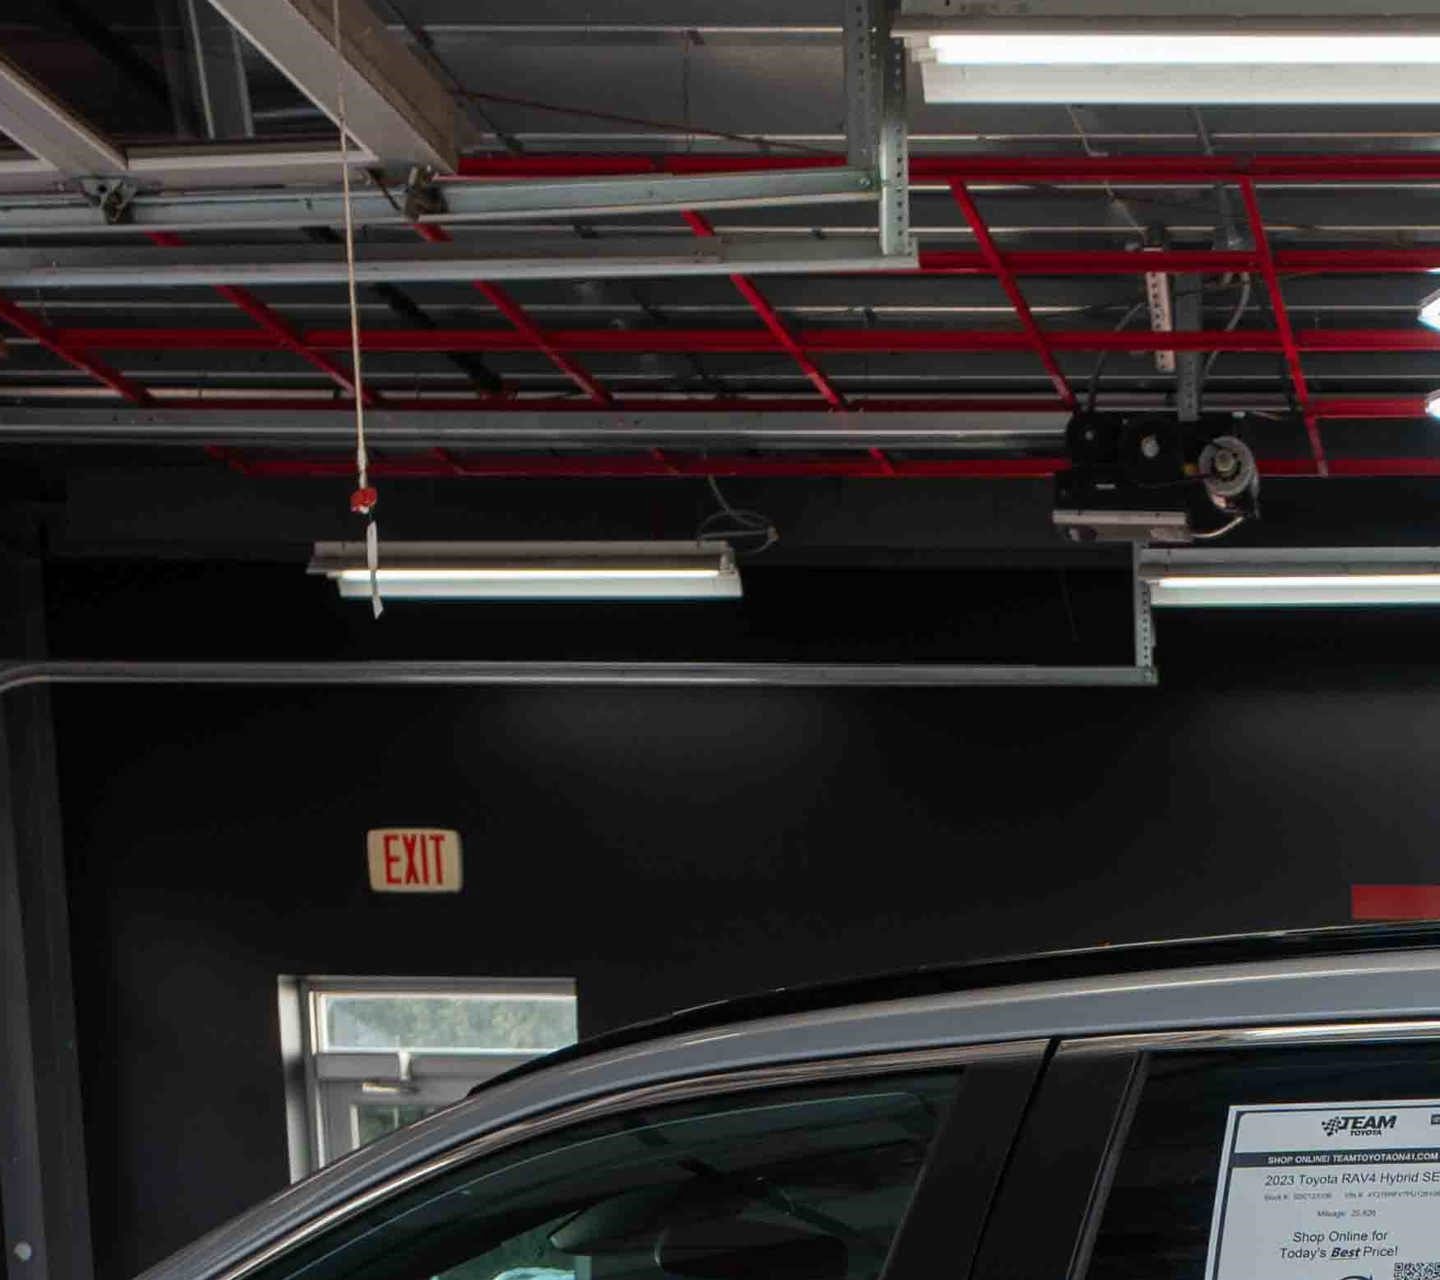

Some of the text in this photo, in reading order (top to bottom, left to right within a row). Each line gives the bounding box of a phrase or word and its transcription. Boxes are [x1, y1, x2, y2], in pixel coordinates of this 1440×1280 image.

[383, 833, 446, 886] EXIT
[1340, 1115, 1396, 1129] TEAM
[1267, 1156, 1293, 1164] SHOP
[1295, 1155, 1330, 1163] ONLINE!
[1264, 1171, 1440, 1187] 2023 Toyota RAV4 Hybrid SE
[1293, 1231, 1388, 1243] Shop Online for
[1279, 1246, 1399, 1260] Today's Best Price!
